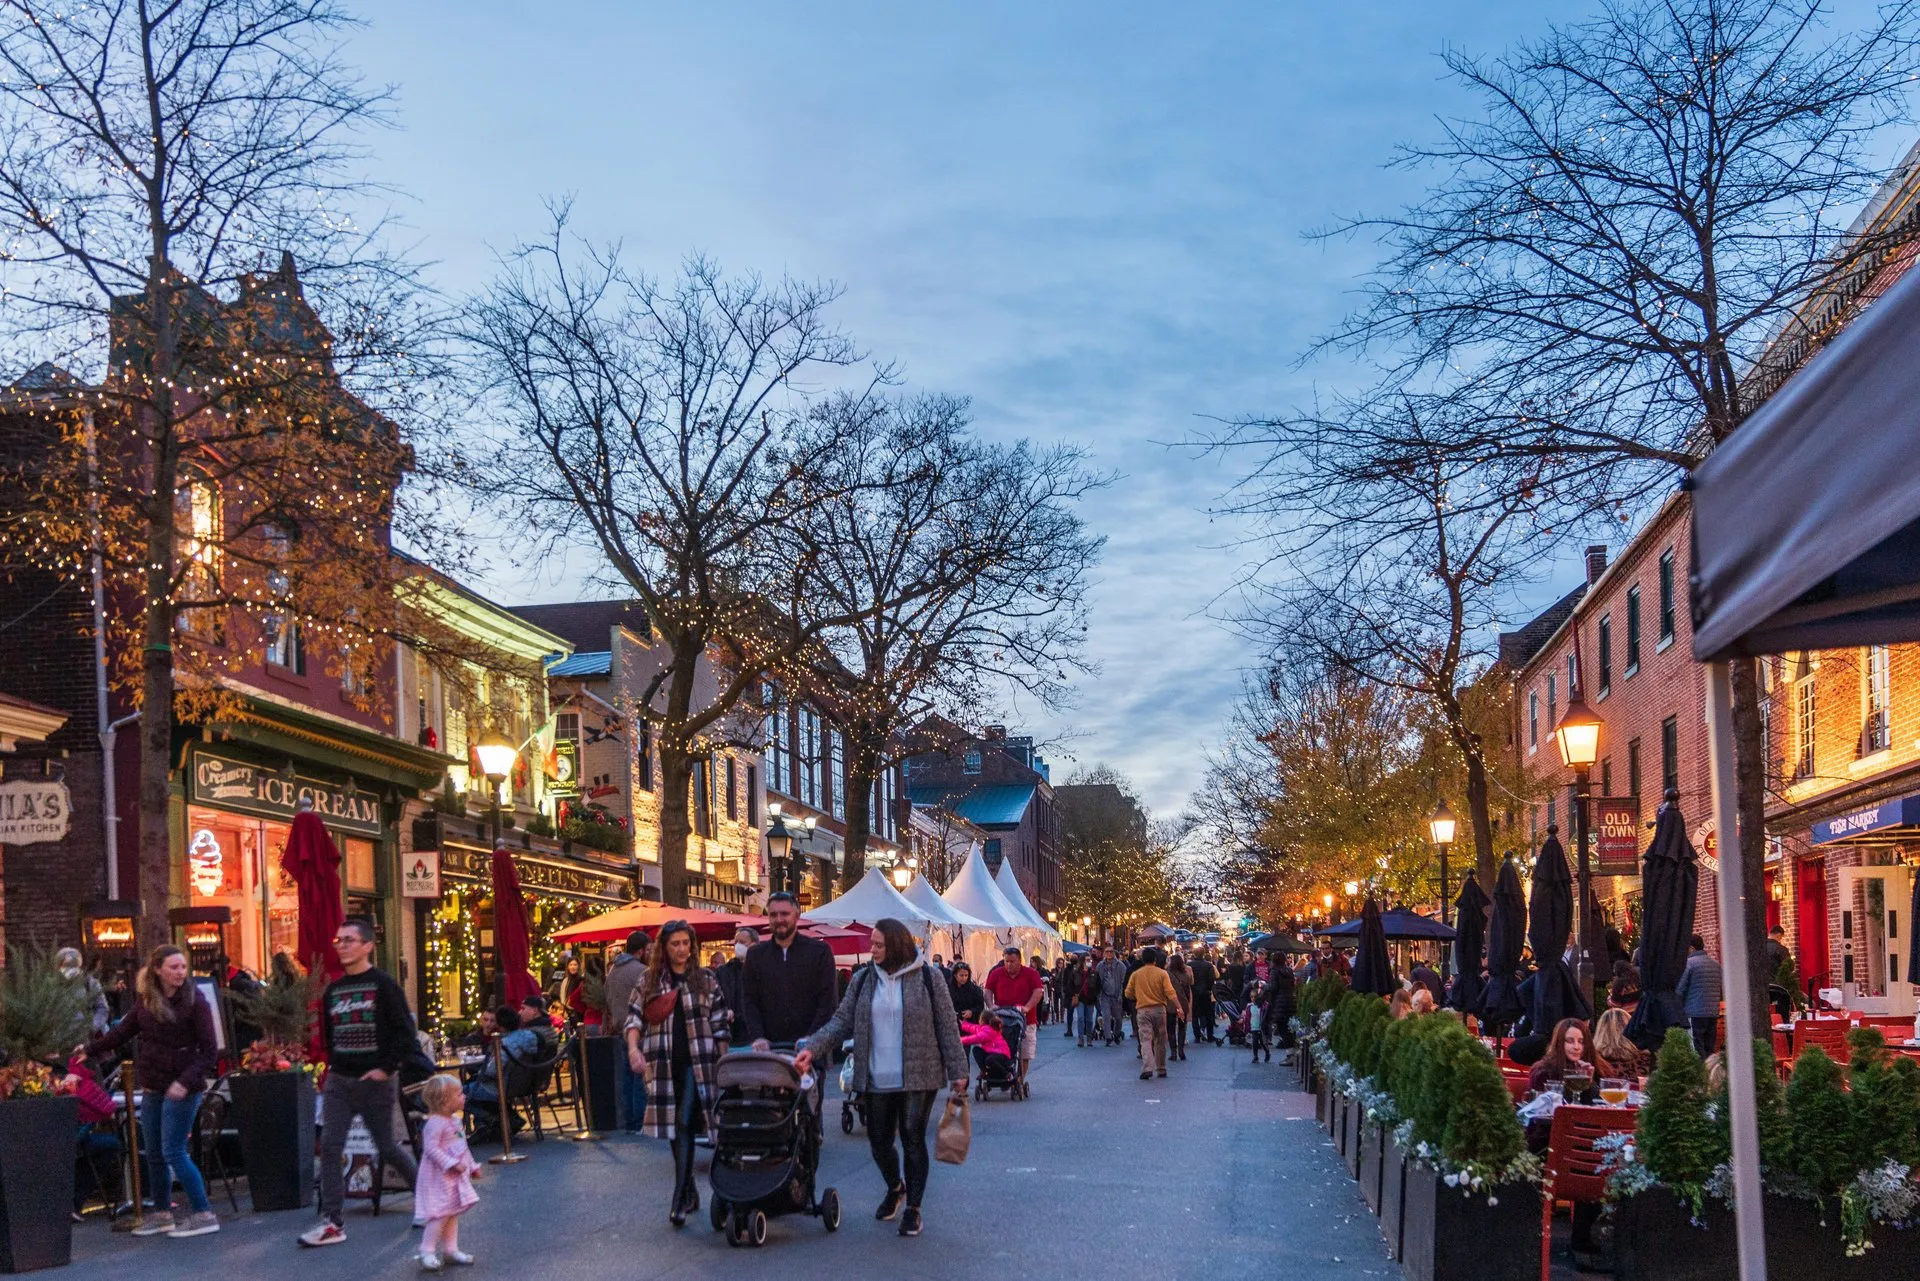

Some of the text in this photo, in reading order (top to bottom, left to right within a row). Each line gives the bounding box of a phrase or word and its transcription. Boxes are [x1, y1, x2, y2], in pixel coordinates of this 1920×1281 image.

[198, 763, 253, 787] Creamery
[0, 792, 60, 819] IA'S
[257, 777, 378, 823] ICE CREAM
[21, 823, 60, 833] KITCHEN
[1605, 812, 1630, 825] OLD
[1829, 808, 1879, 835] FISH MARKET
[1600, 825, 1636, 838] TOWN
[1699, 821, 1716, 837] OLD
